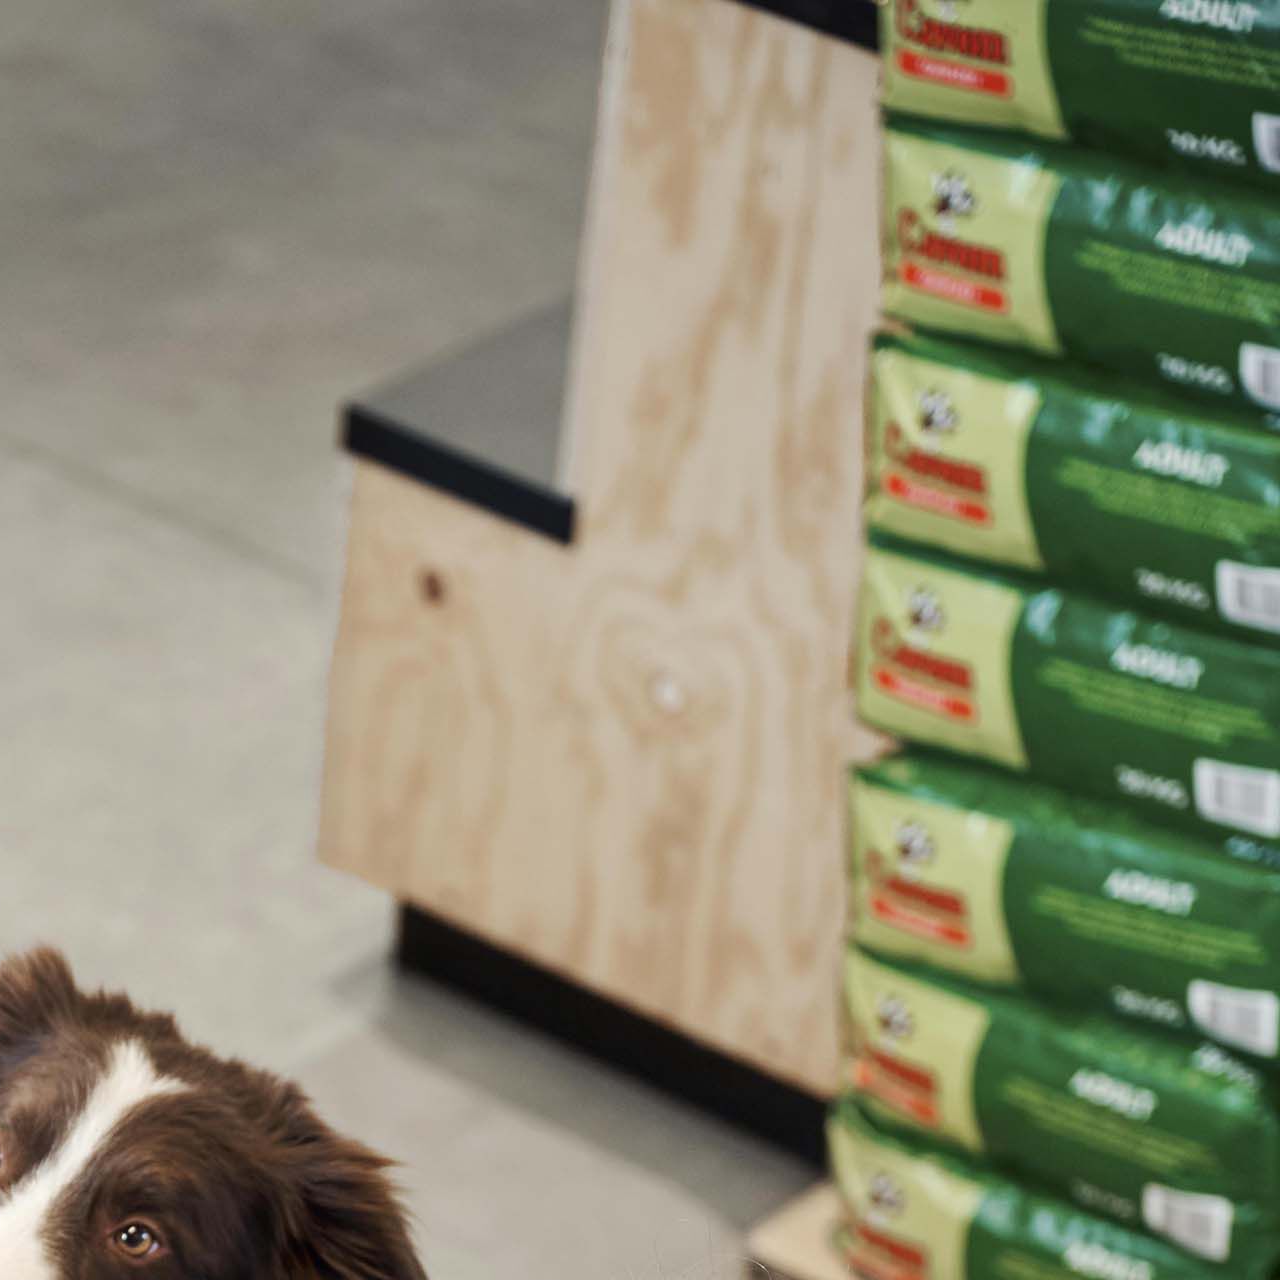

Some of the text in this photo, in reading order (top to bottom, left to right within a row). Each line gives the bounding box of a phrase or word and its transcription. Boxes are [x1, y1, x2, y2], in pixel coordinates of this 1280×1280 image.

[1154, 221, 1254, 267] ADULT
[1133, 440, 1228, 487] ADULT
[1111, 641, 1202, 688] ADULT
[1104, 869, 1195, 915] ADULT
